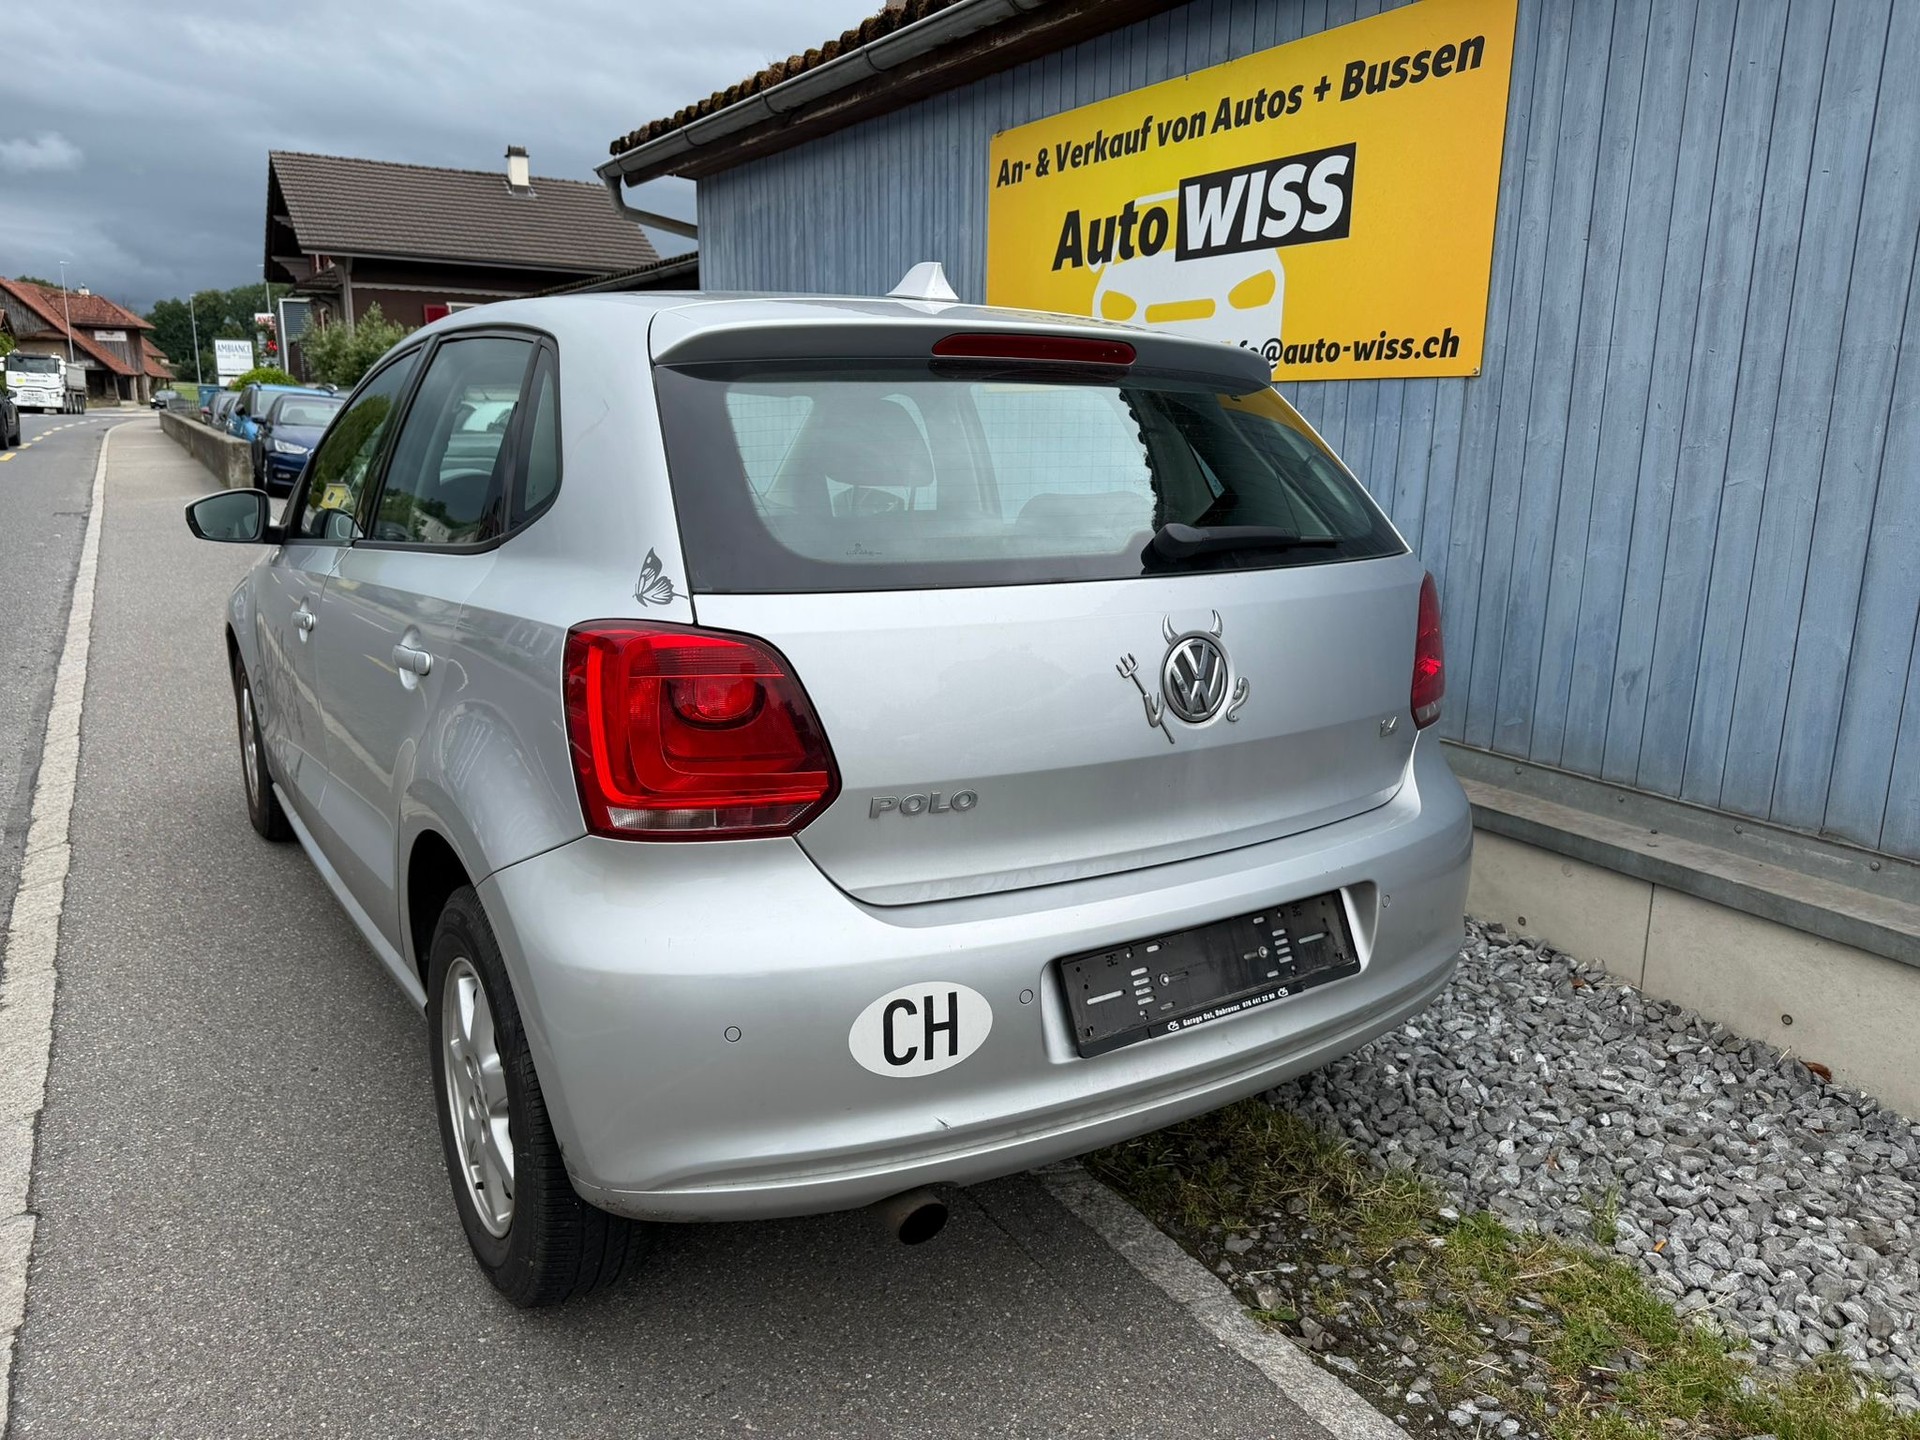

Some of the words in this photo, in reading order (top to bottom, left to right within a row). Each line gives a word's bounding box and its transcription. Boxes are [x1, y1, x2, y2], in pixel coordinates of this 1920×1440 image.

[996, 158, 1031, 188] An-
[1035, 147, 1051, 178] &
[1055, 115, 1153, 172] Verkauf
[1157, 110, 1206, 147] von
[1210, 88, 1304, 135] Autos
[1313, 75, 1331, 102] +
[1340, 34, 1485, 102] Bussen
[1051, 200, 1169, 271] Auto
[1185, 154, 1350, 251] WISS
[869, 789, 979, 819] POLO
[882, 991, 959, 1066] CH
